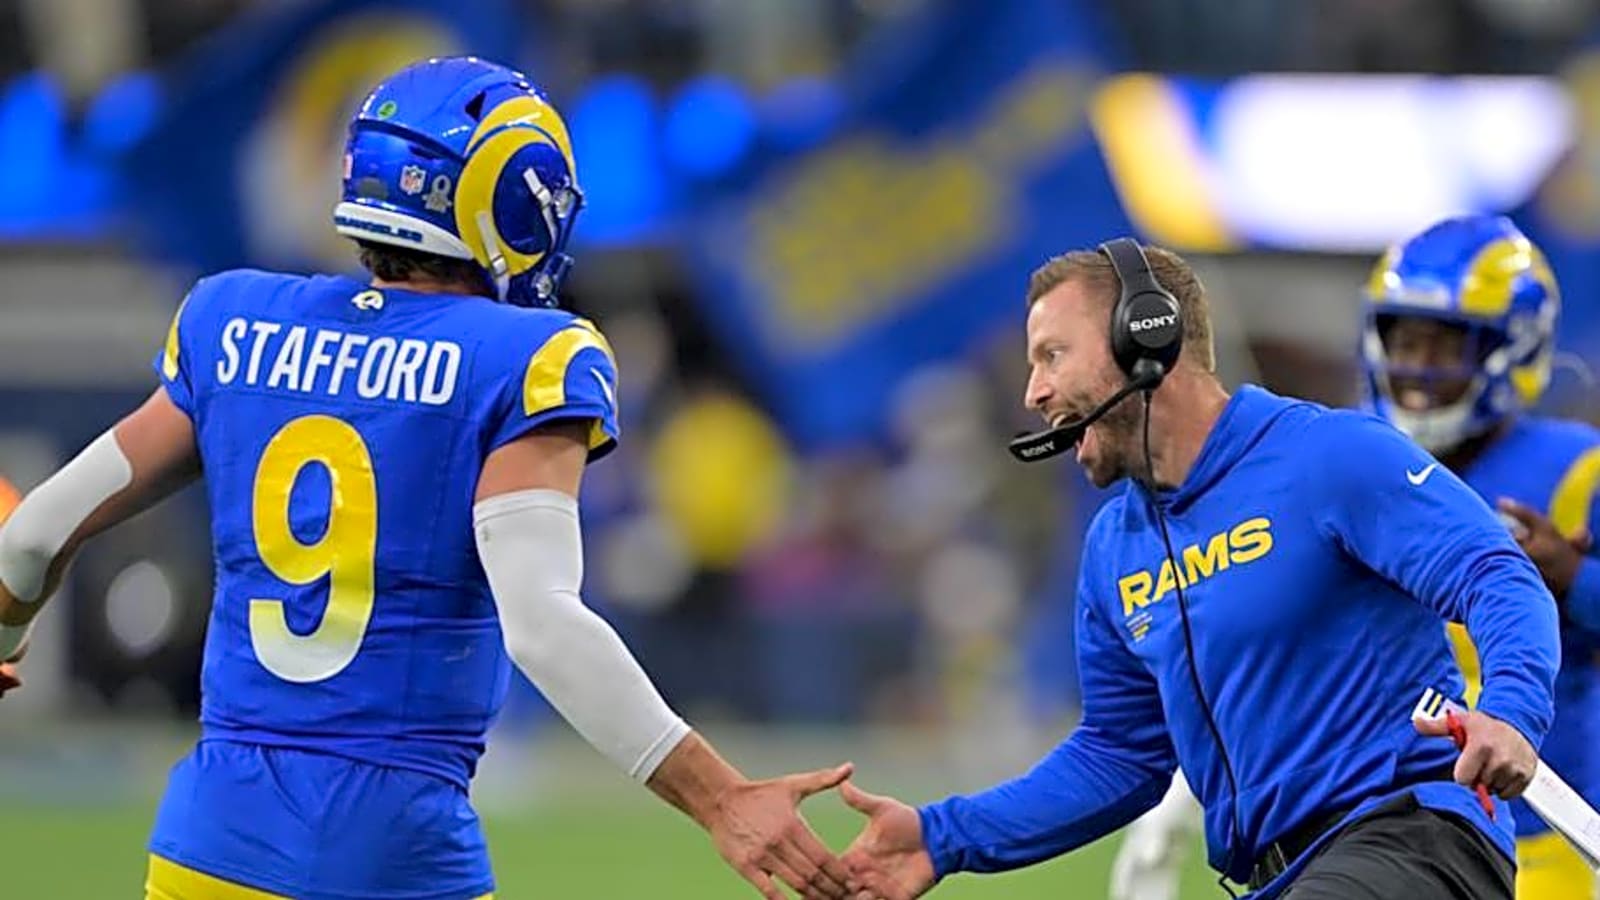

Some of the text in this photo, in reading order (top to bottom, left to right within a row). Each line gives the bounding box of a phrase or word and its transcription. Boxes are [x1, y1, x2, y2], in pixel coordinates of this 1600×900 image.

[217, 317, 462, 406] STAFFORD
[1130, 315, 1176, 331] SONY
[1021, 440, 1055, 457] SONY
[249, 414, 378, 683] 9
[1118, 517, 1273, 617] RAMS
